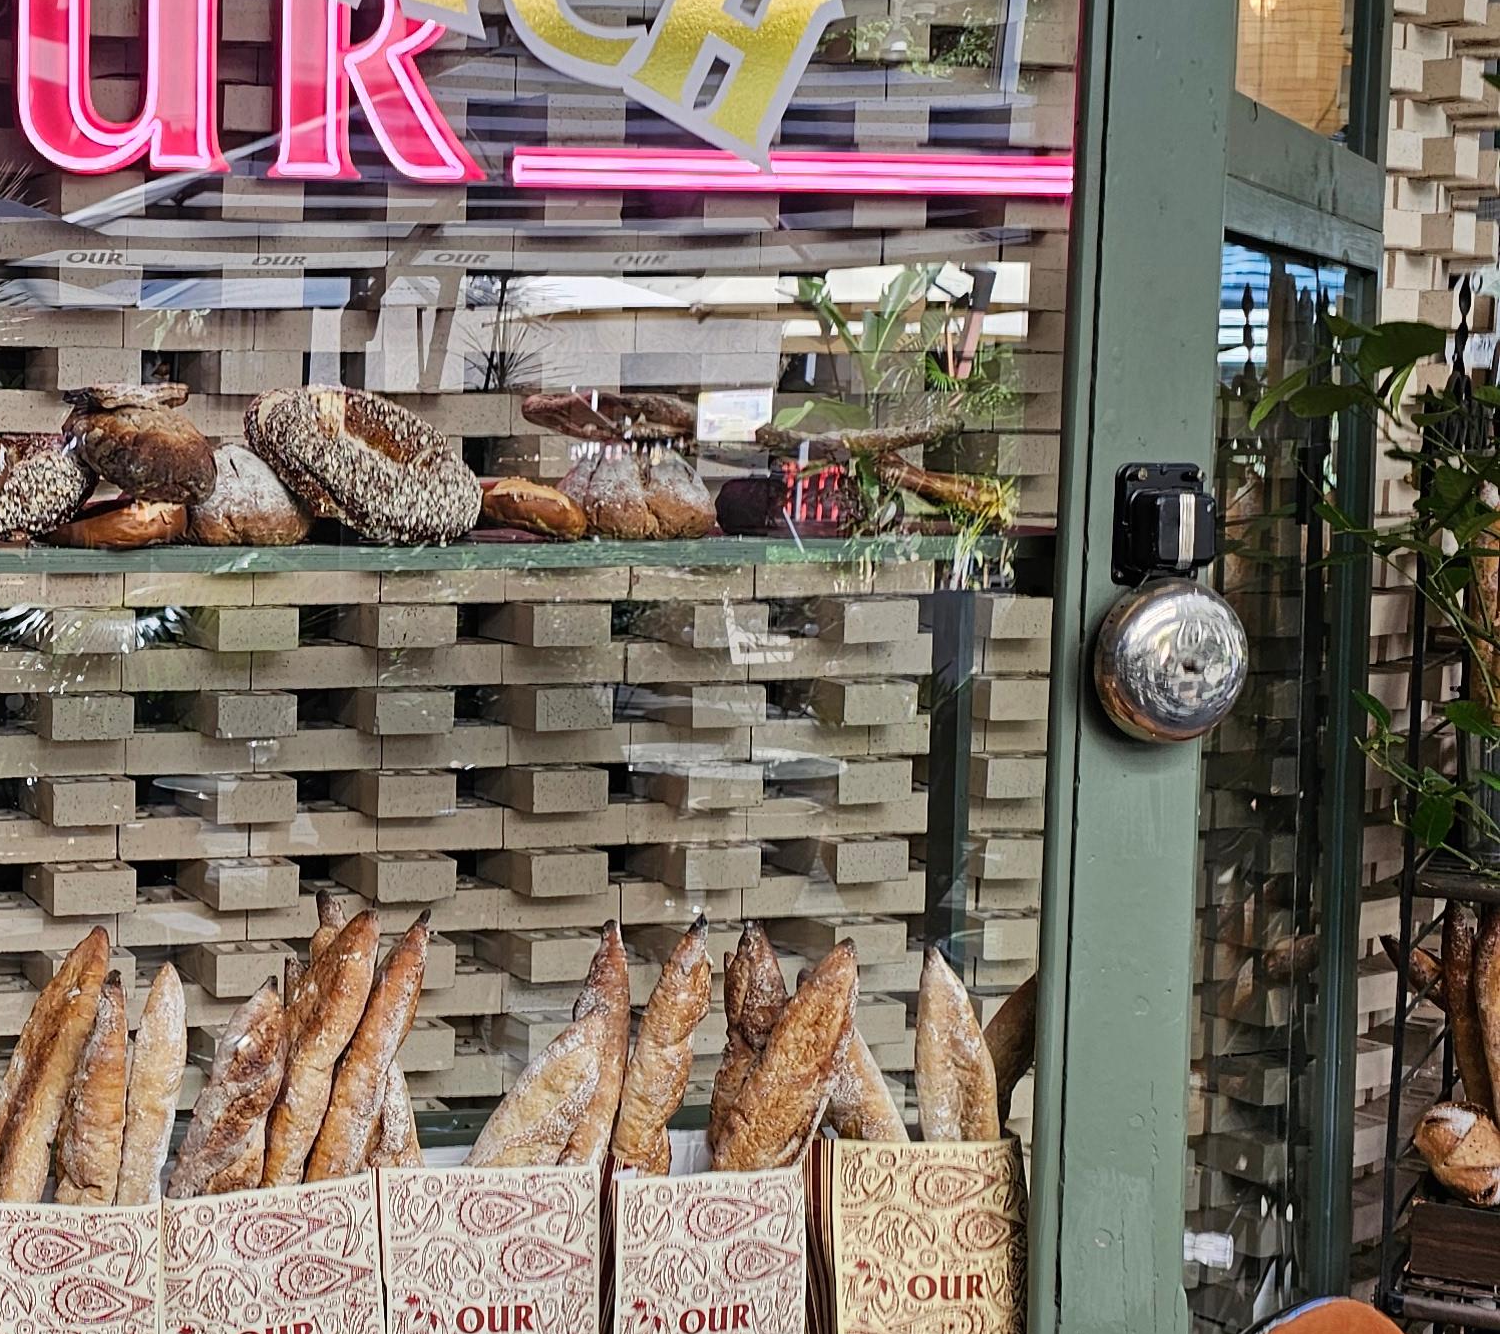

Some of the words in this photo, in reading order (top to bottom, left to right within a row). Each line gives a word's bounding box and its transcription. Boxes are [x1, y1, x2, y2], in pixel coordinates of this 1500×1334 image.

[66, 250, 124, 266] OUR
[433, 252, 491, 266] OUR
[907, 1273, 986, 1302] OUR
[456, 1305, 534, 1334] OUR
[678, 1303, 751, 1334] OUR
